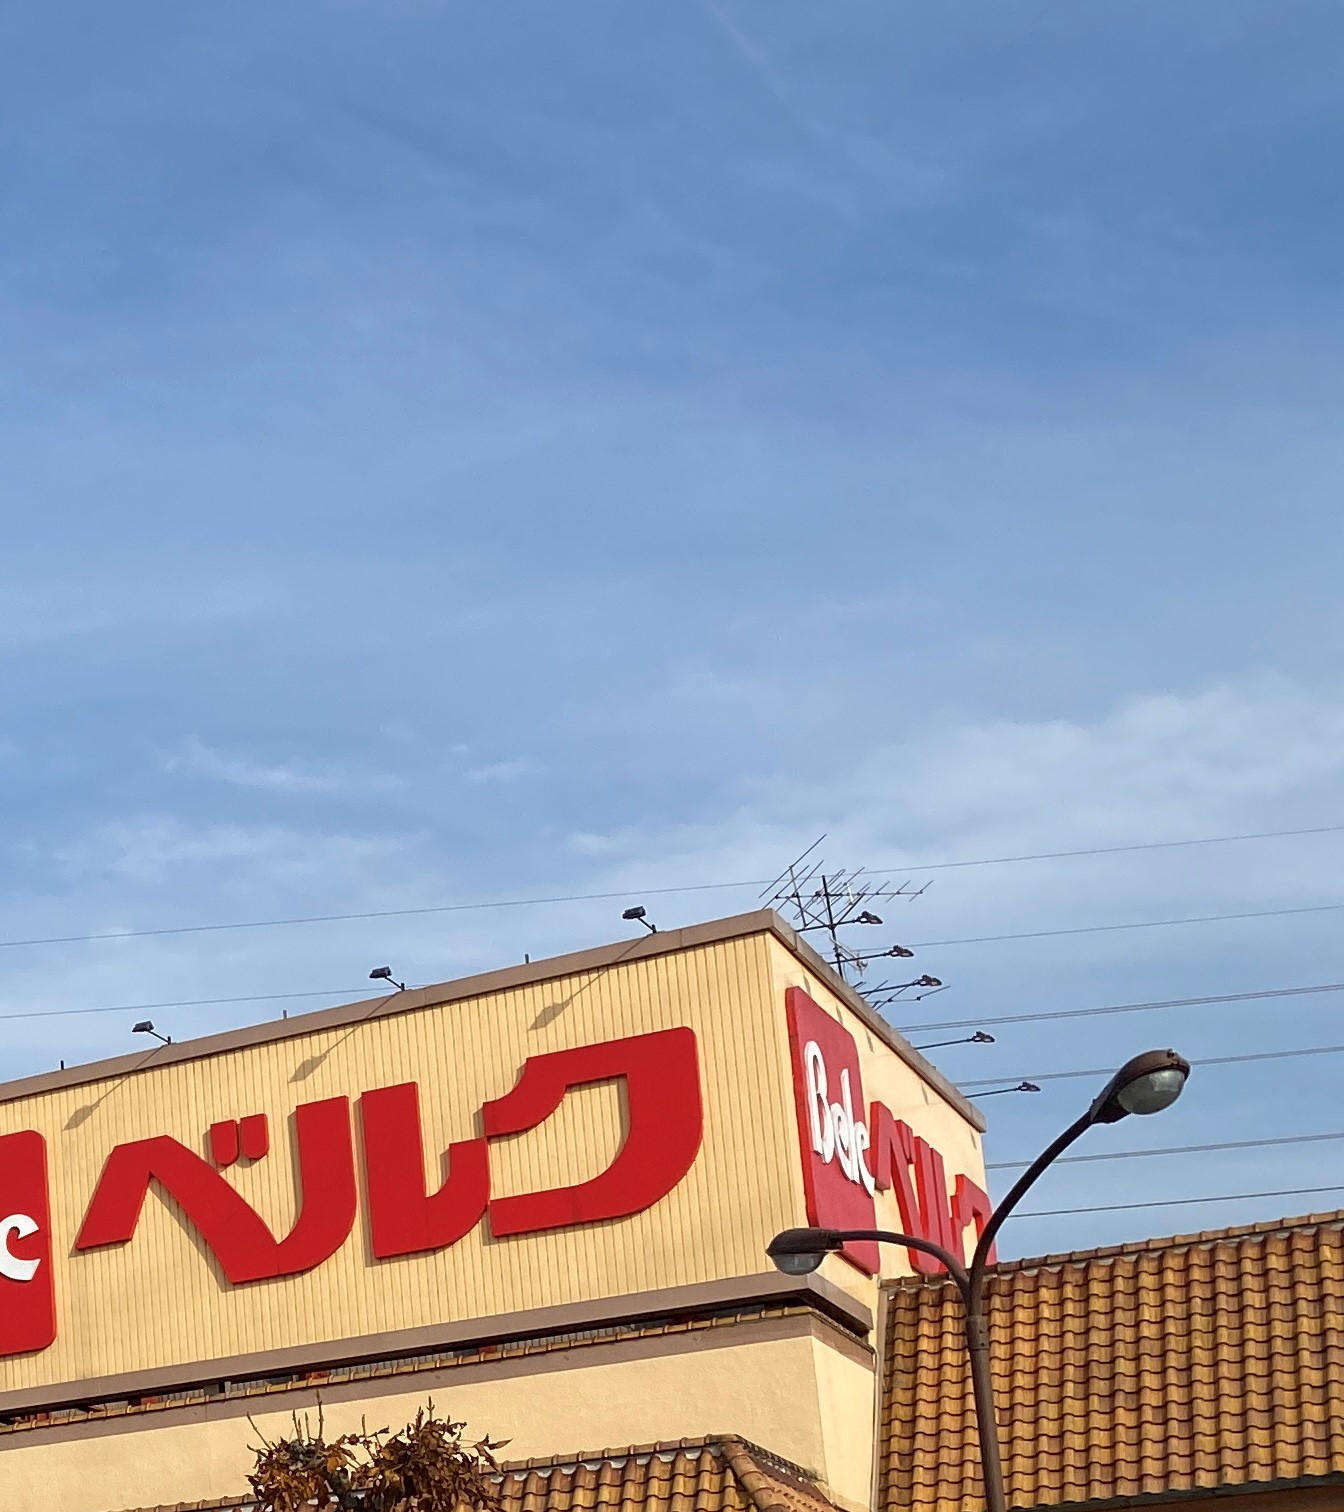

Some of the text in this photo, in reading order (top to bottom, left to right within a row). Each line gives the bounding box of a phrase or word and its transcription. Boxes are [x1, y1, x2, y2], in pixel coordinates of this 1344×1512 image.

[74, 1026, 704, 1286] ベルク
[803, 1040, 875, 1198] Belc
